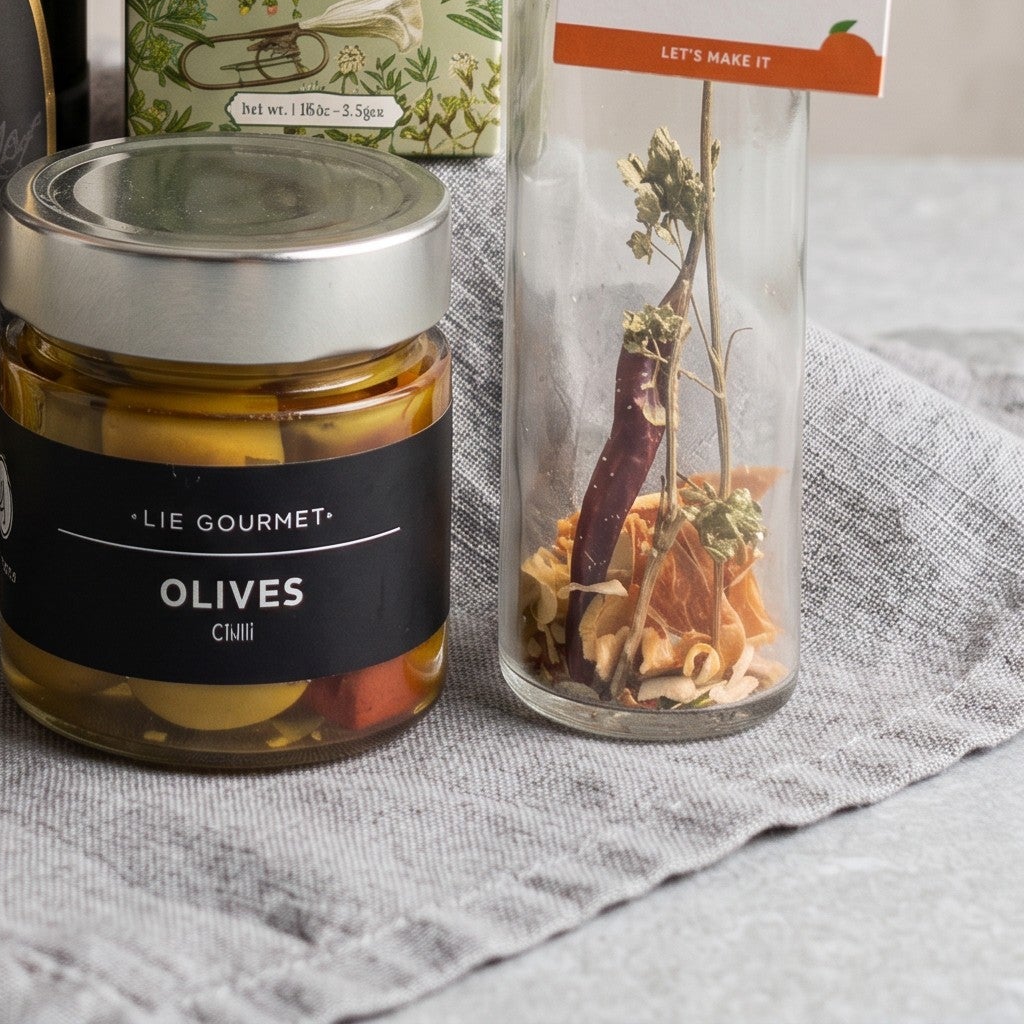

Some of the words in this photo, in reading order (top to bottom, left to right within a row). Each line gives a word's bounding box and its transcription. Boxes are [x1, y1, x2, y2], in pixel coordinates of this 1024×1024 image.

[661, 46, 702, 62] LET'S
[707, 51, 751, 67] MAKE
[756, 56, 772, 69] IT
[143, 509, 183, 531] LIE
[196, 507, 326, 532] GOURMET
[160, 577, 304, 610] OLIVES
